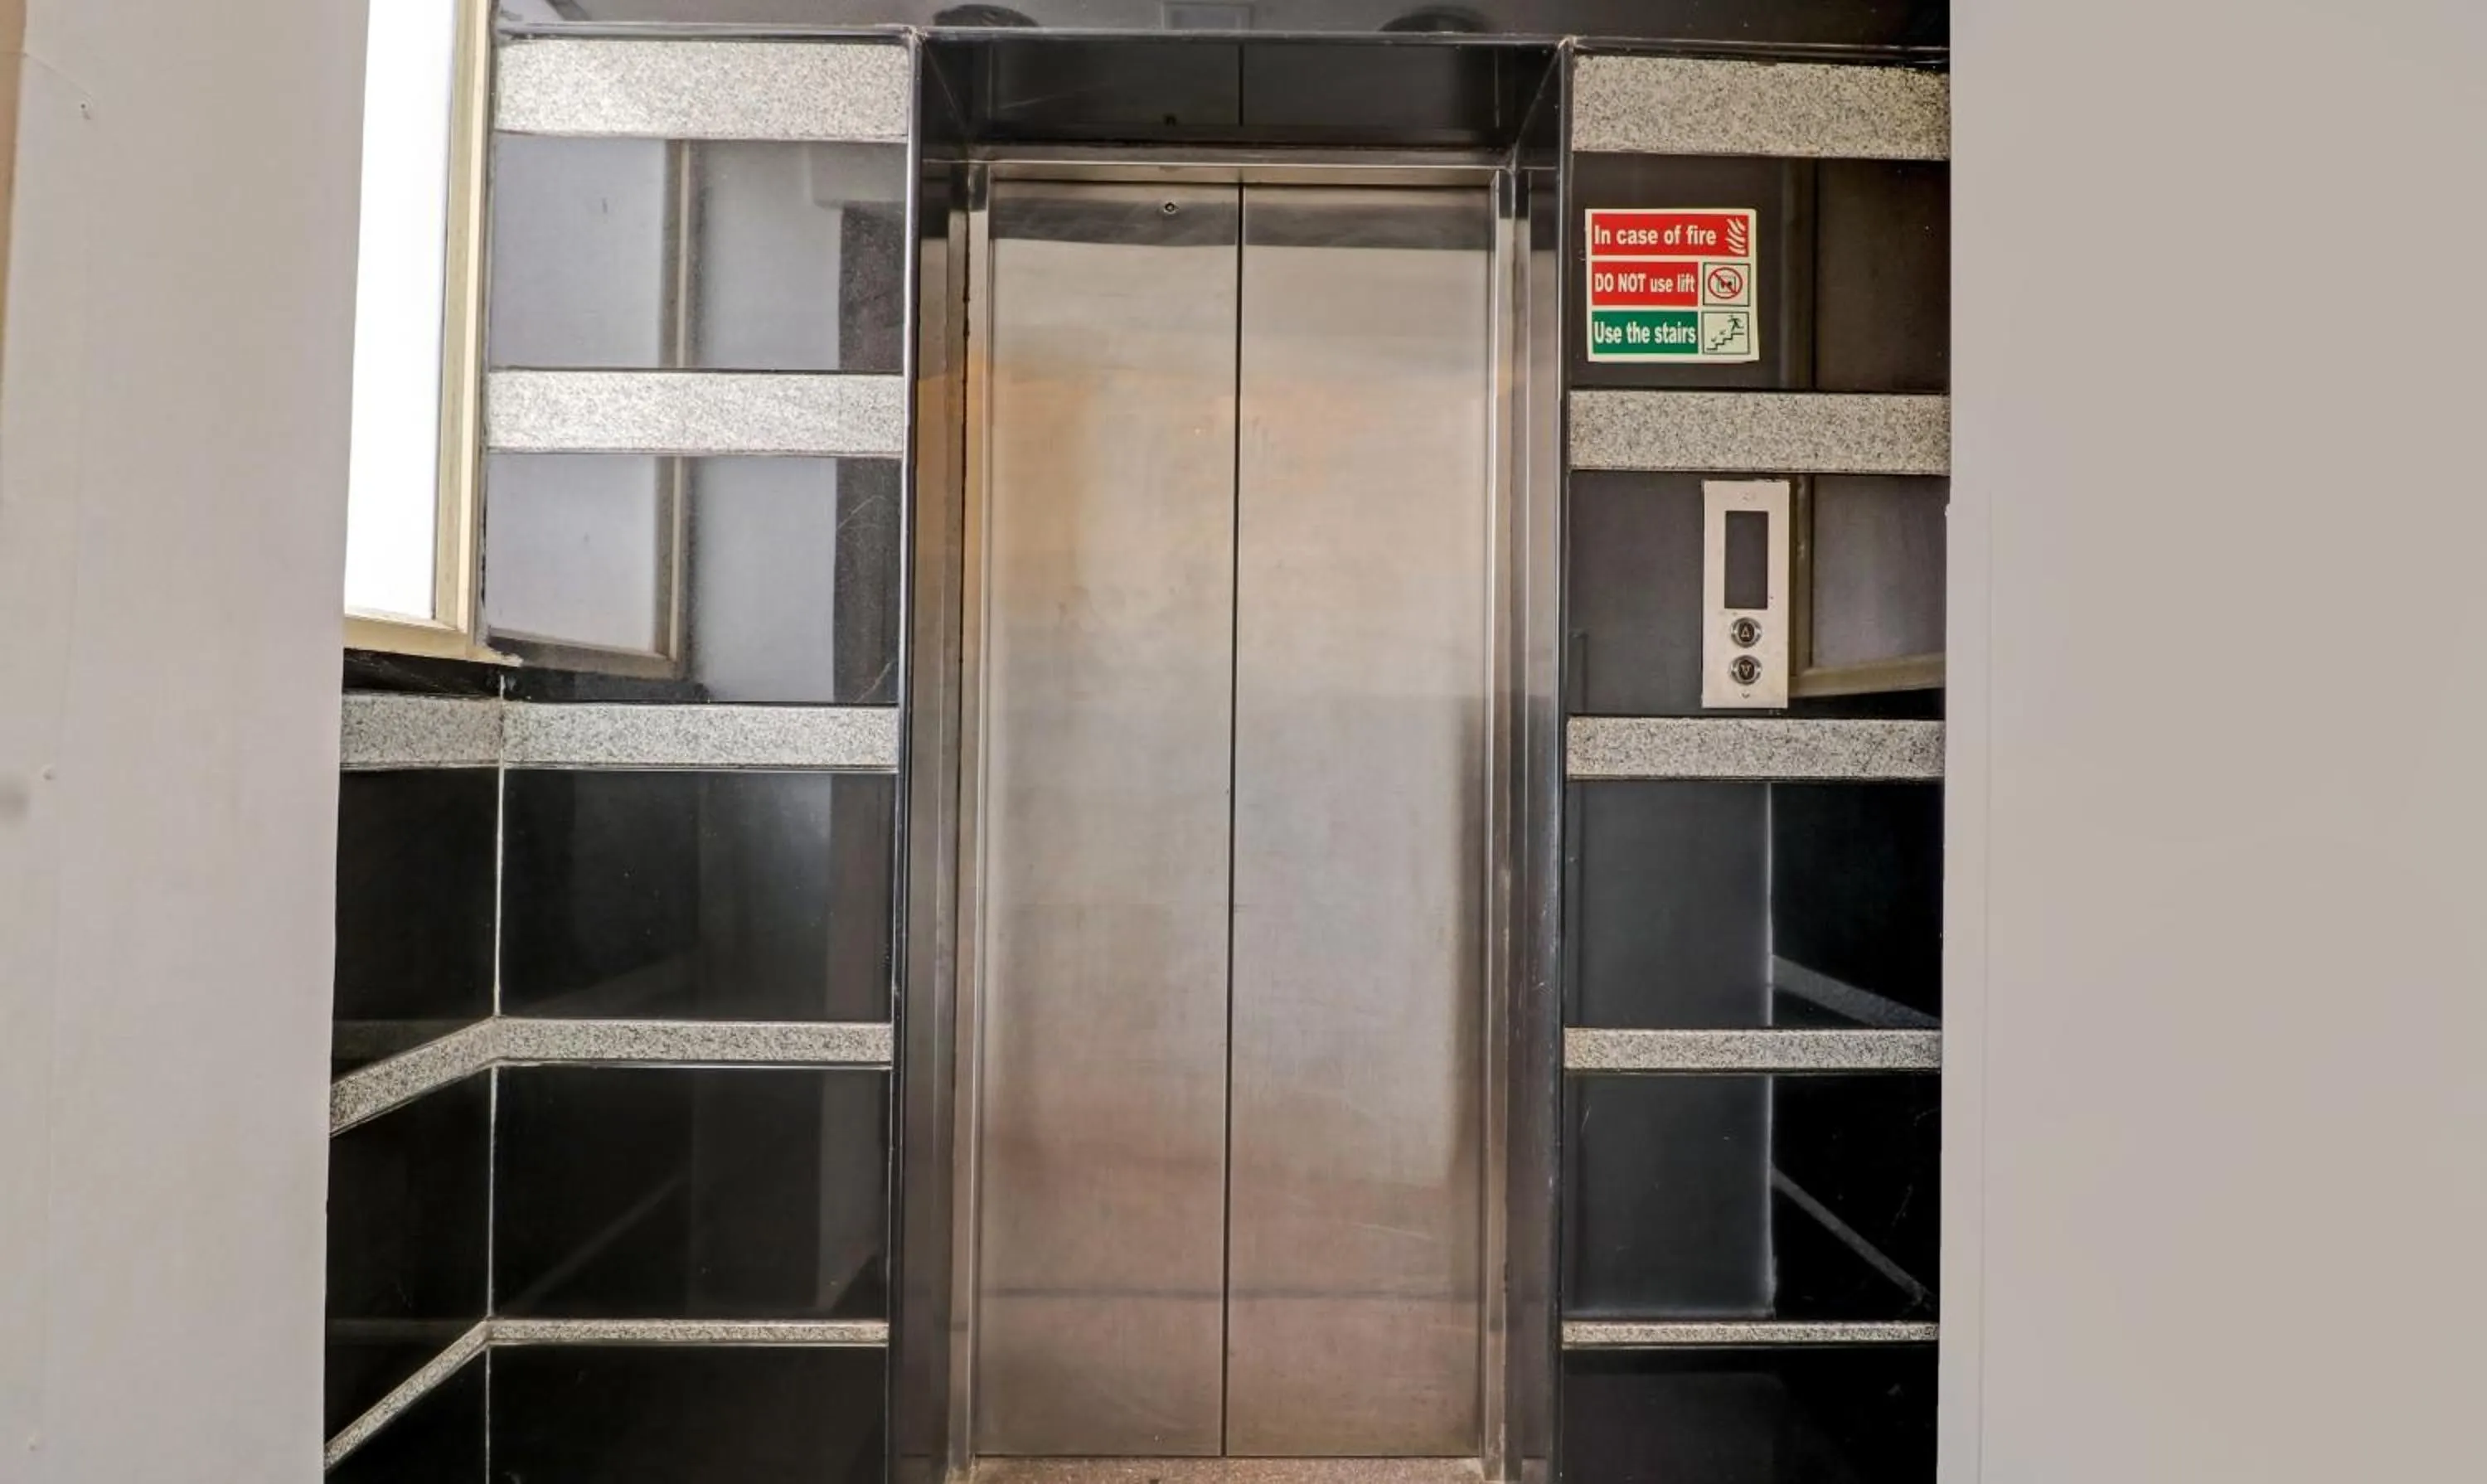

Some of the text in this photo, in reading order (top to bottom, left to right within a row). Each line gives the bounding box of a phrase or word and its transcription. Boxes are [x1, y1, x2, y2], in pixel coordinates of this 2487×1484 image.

[1594, 225, 1717, 245] In case of fire
[1594, 273, 1696, 293] DO NOT use lift
[1594, 322, 1697, 344] Use the stairs
